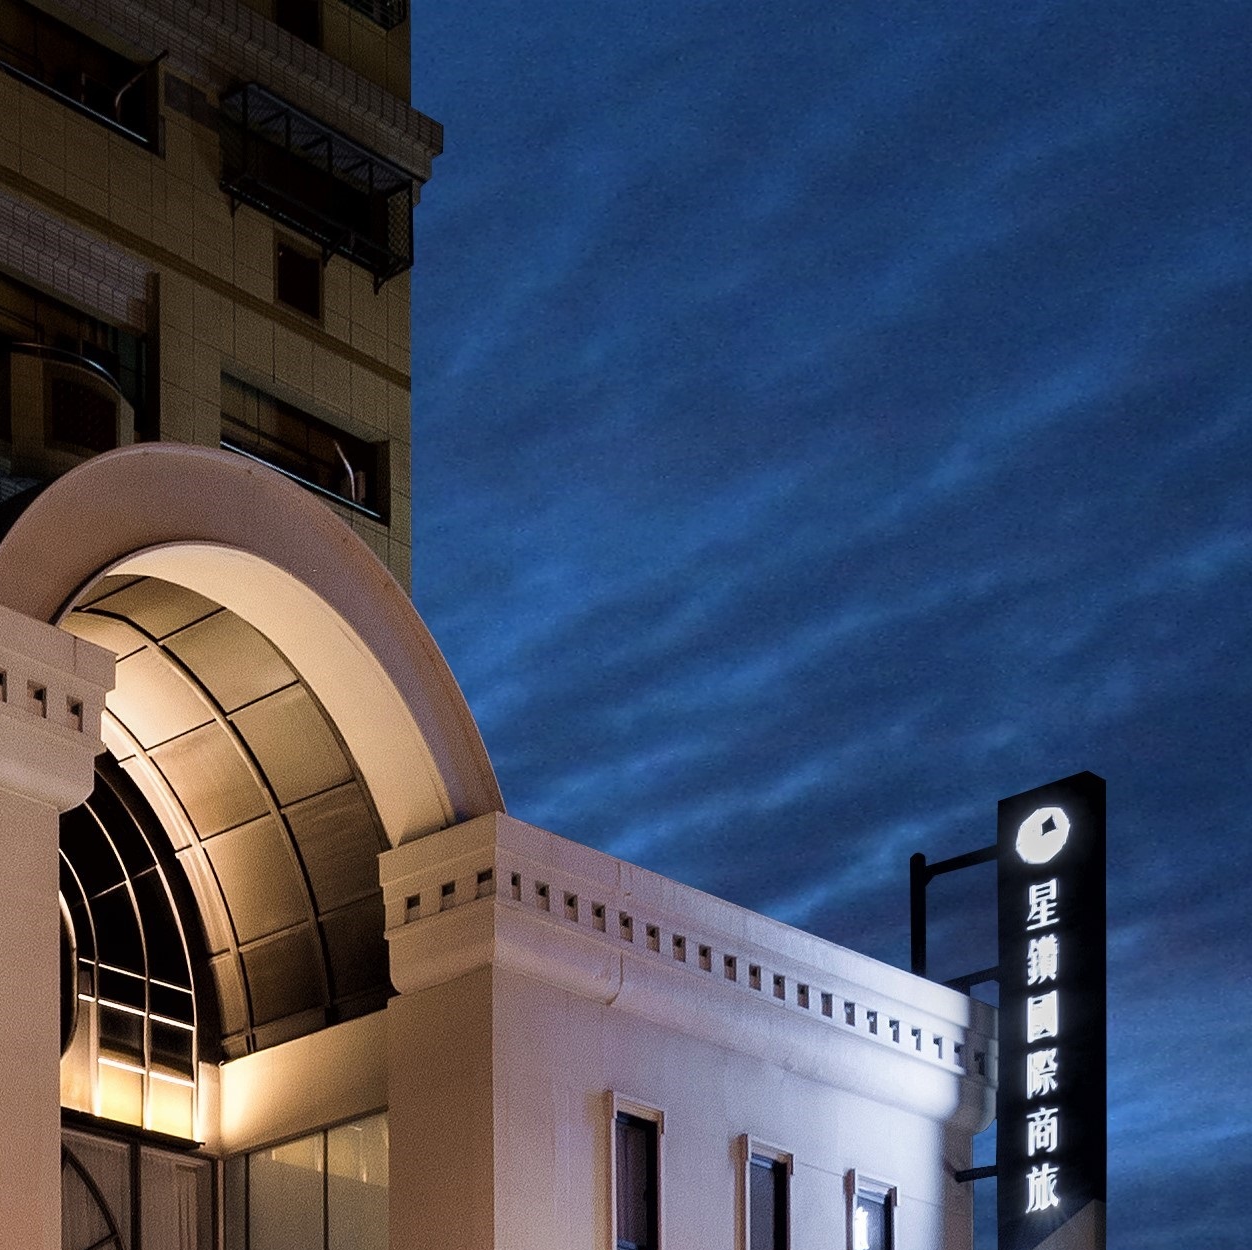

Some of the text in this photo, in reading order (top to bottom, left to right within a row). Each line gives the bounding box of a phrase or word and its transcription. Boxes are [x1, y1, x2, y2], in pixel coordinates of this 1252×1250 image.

[1025, 878, 1061, 1215] 星鑽國際商旅
